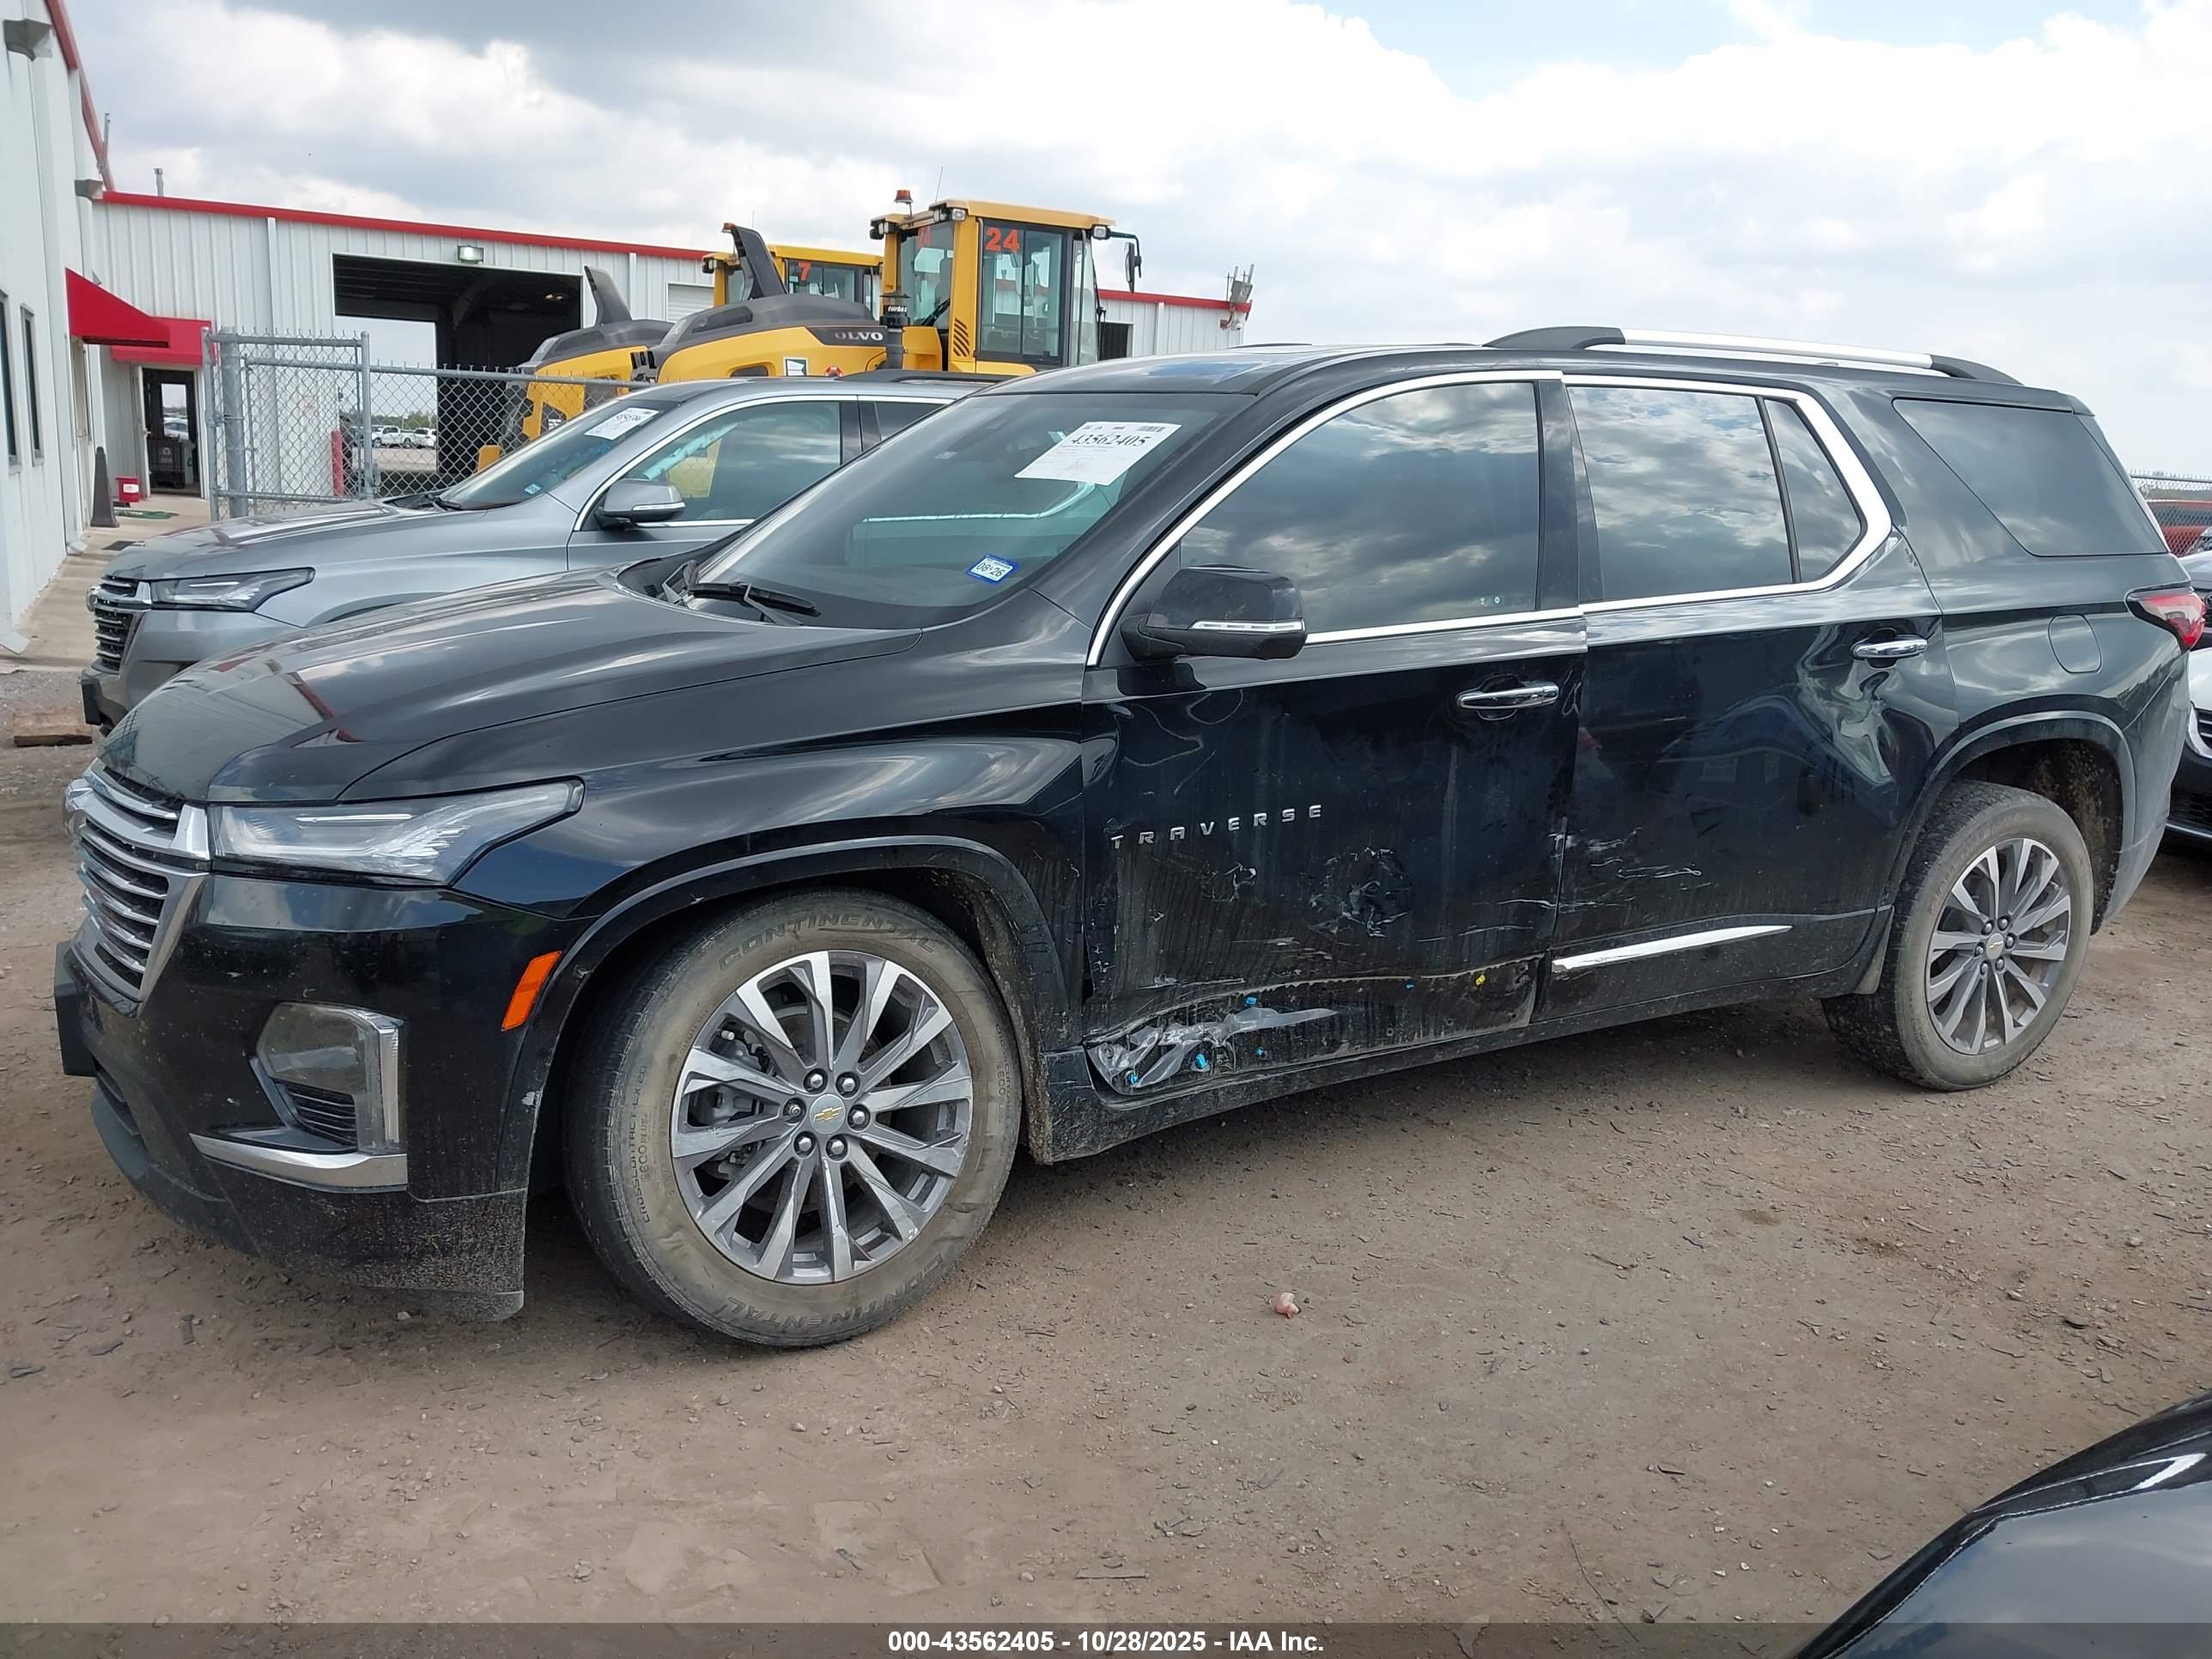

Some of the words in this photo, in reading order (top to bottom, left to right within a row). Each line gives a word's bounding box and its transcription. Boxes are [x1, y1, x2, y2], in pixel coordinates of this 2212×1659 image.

[985, 227, 1020, 252] 24
[799, 261, 811, 282] 7
[1072, 434, 1151, 447] 43562405
[1110, 805, 1322, 849] TRAVERSE
[719, 913, 935, 971] CONTINENTAL
